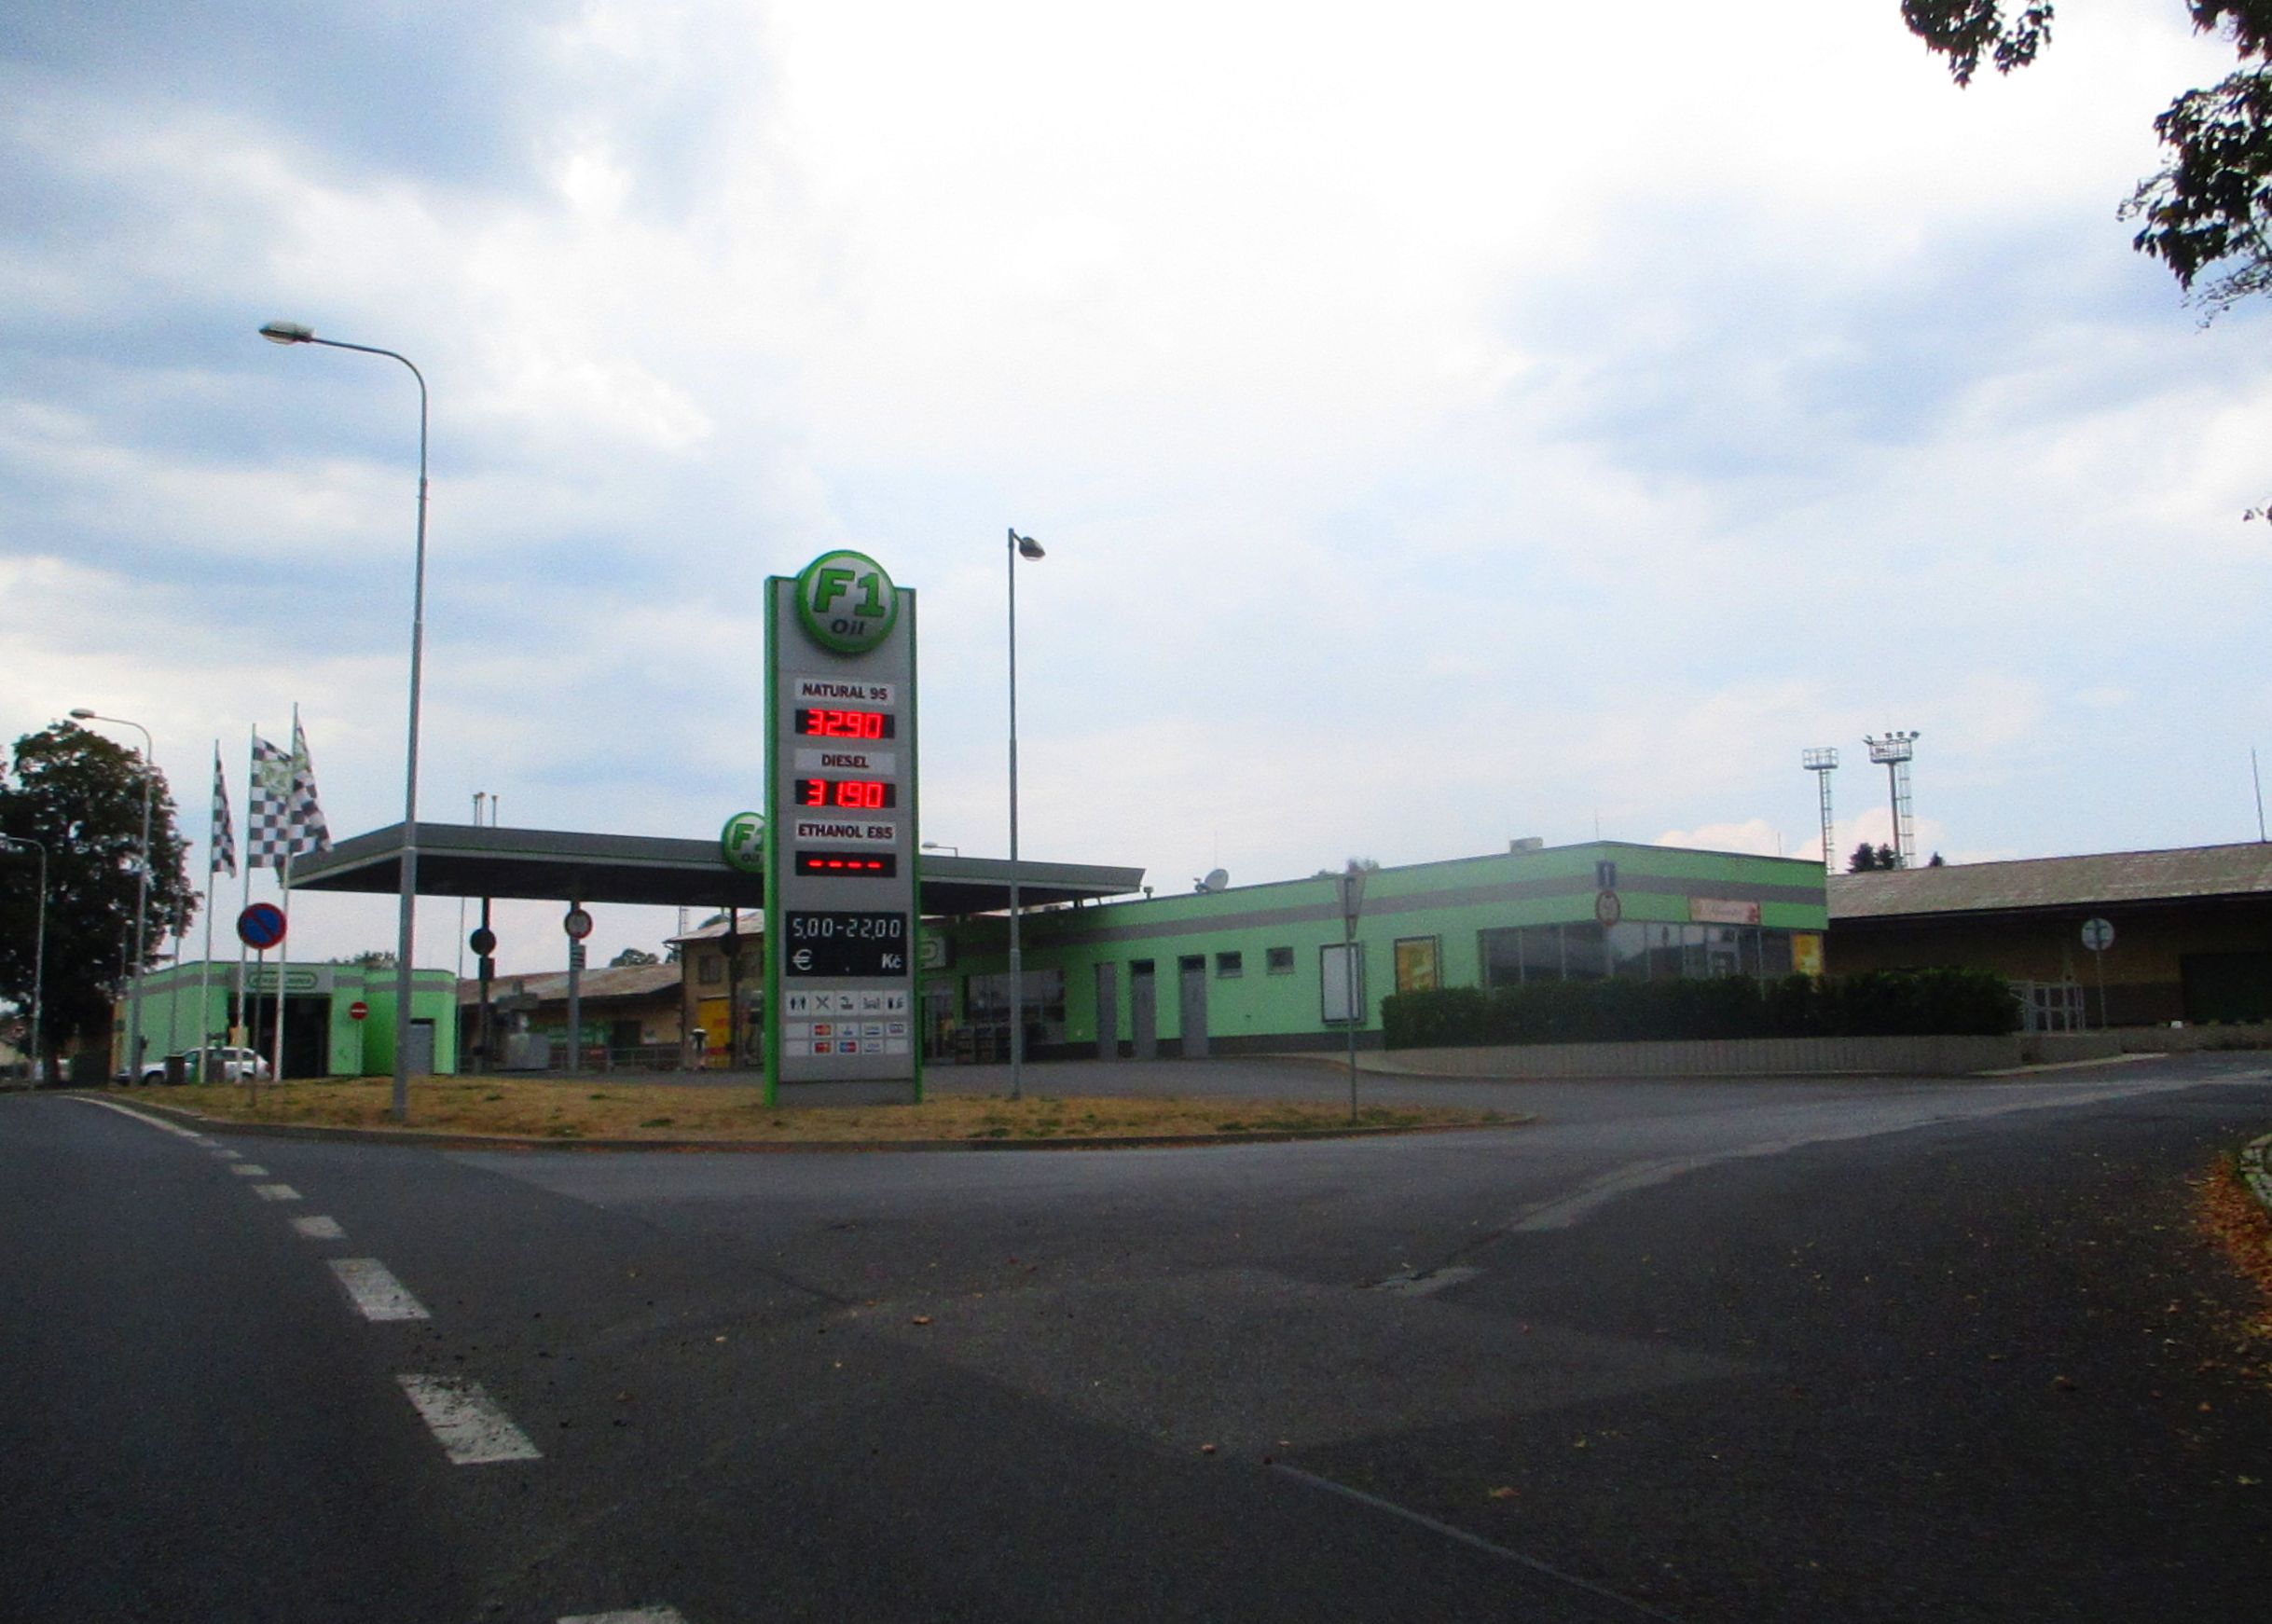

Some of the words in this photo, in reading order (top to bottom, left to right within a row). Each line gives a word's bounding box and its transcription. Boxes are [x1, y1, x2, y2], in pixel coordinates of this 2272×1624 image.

[813, 568, 886, 618] F1
[831, 619, 865, 636] Oil
[802, 683, 865, 699] NATURAL
[870, 687, 888, 700] 95
[820, 753, 870, 768] DIESEL
[798, 823, 863, 838] ETHANOL
